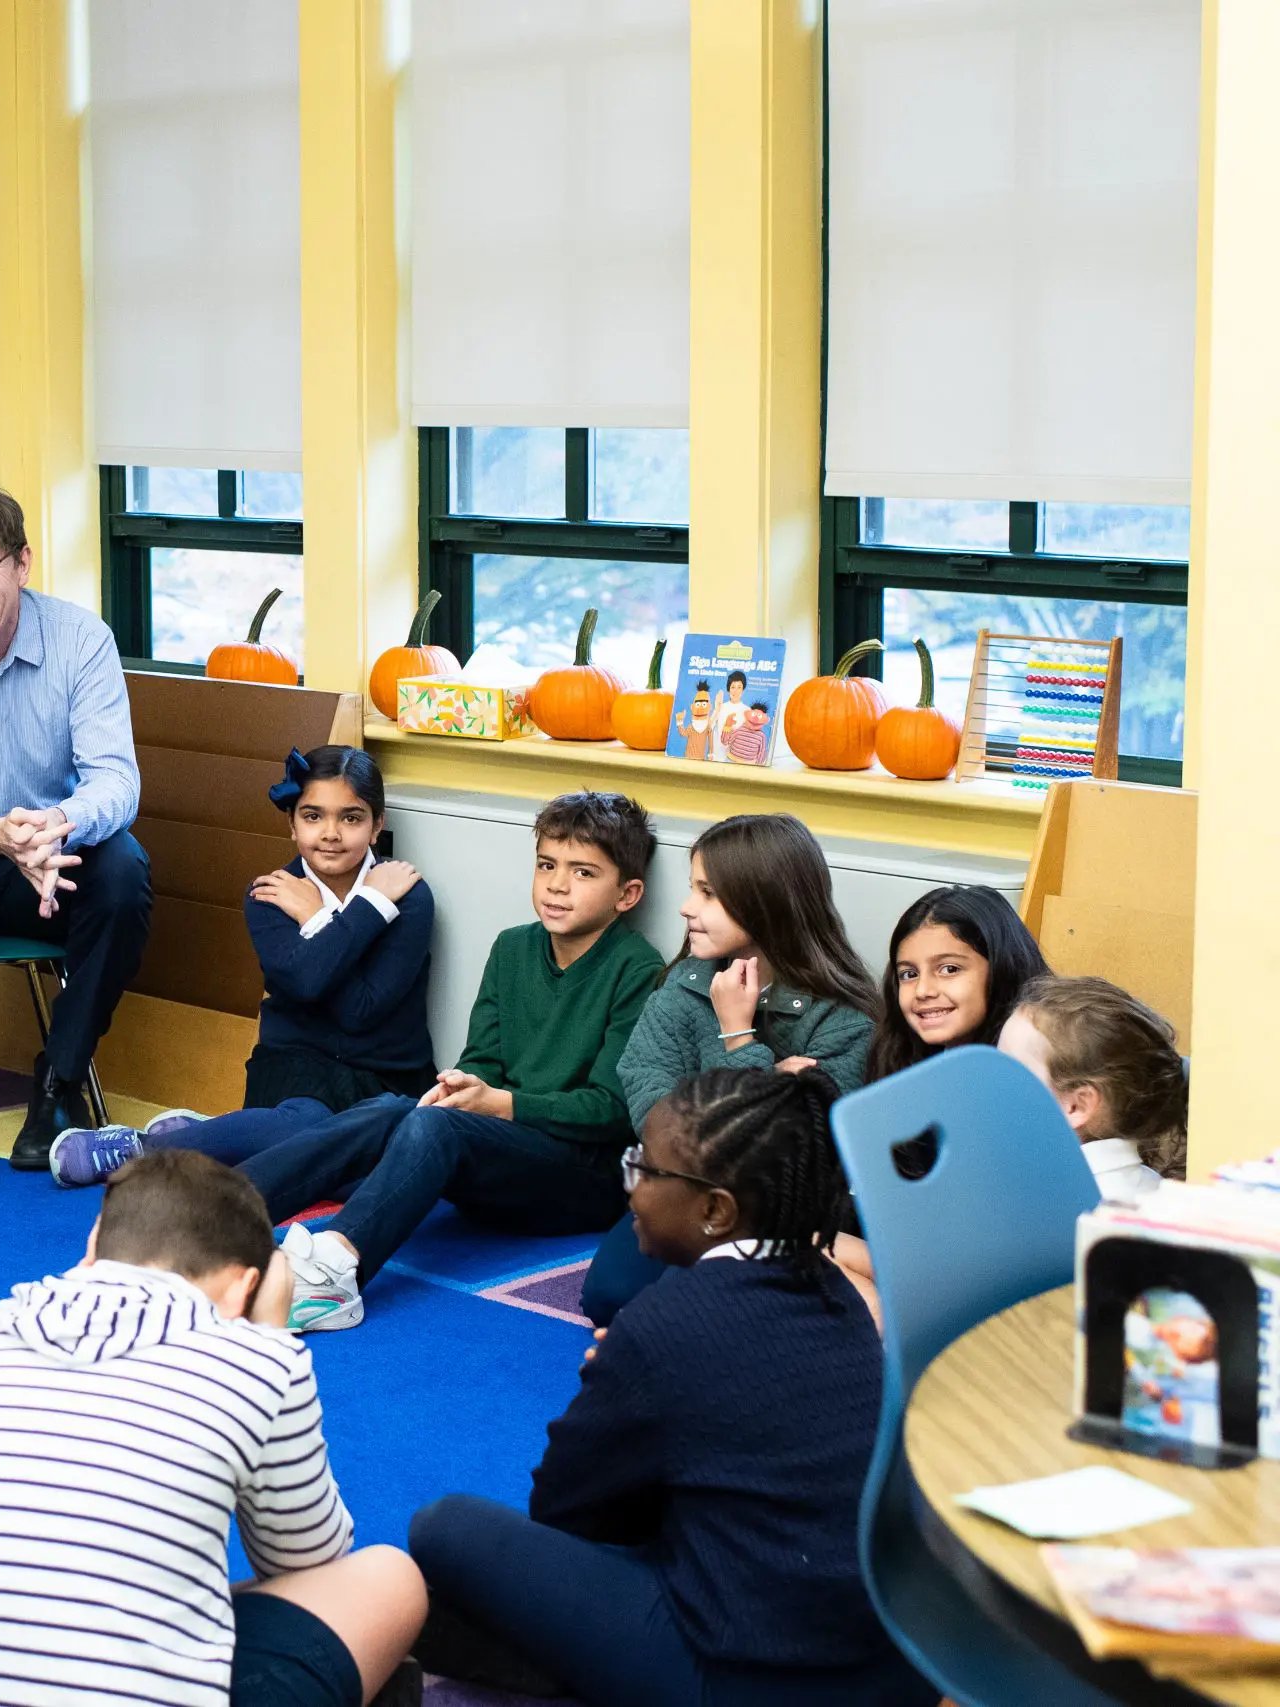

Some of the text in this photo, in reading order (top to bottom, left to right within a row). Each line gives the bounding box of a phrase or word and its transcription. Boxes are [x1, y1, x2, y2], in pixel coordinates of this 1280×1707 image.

[688, 655, 778, 672] Sign Language ABC
